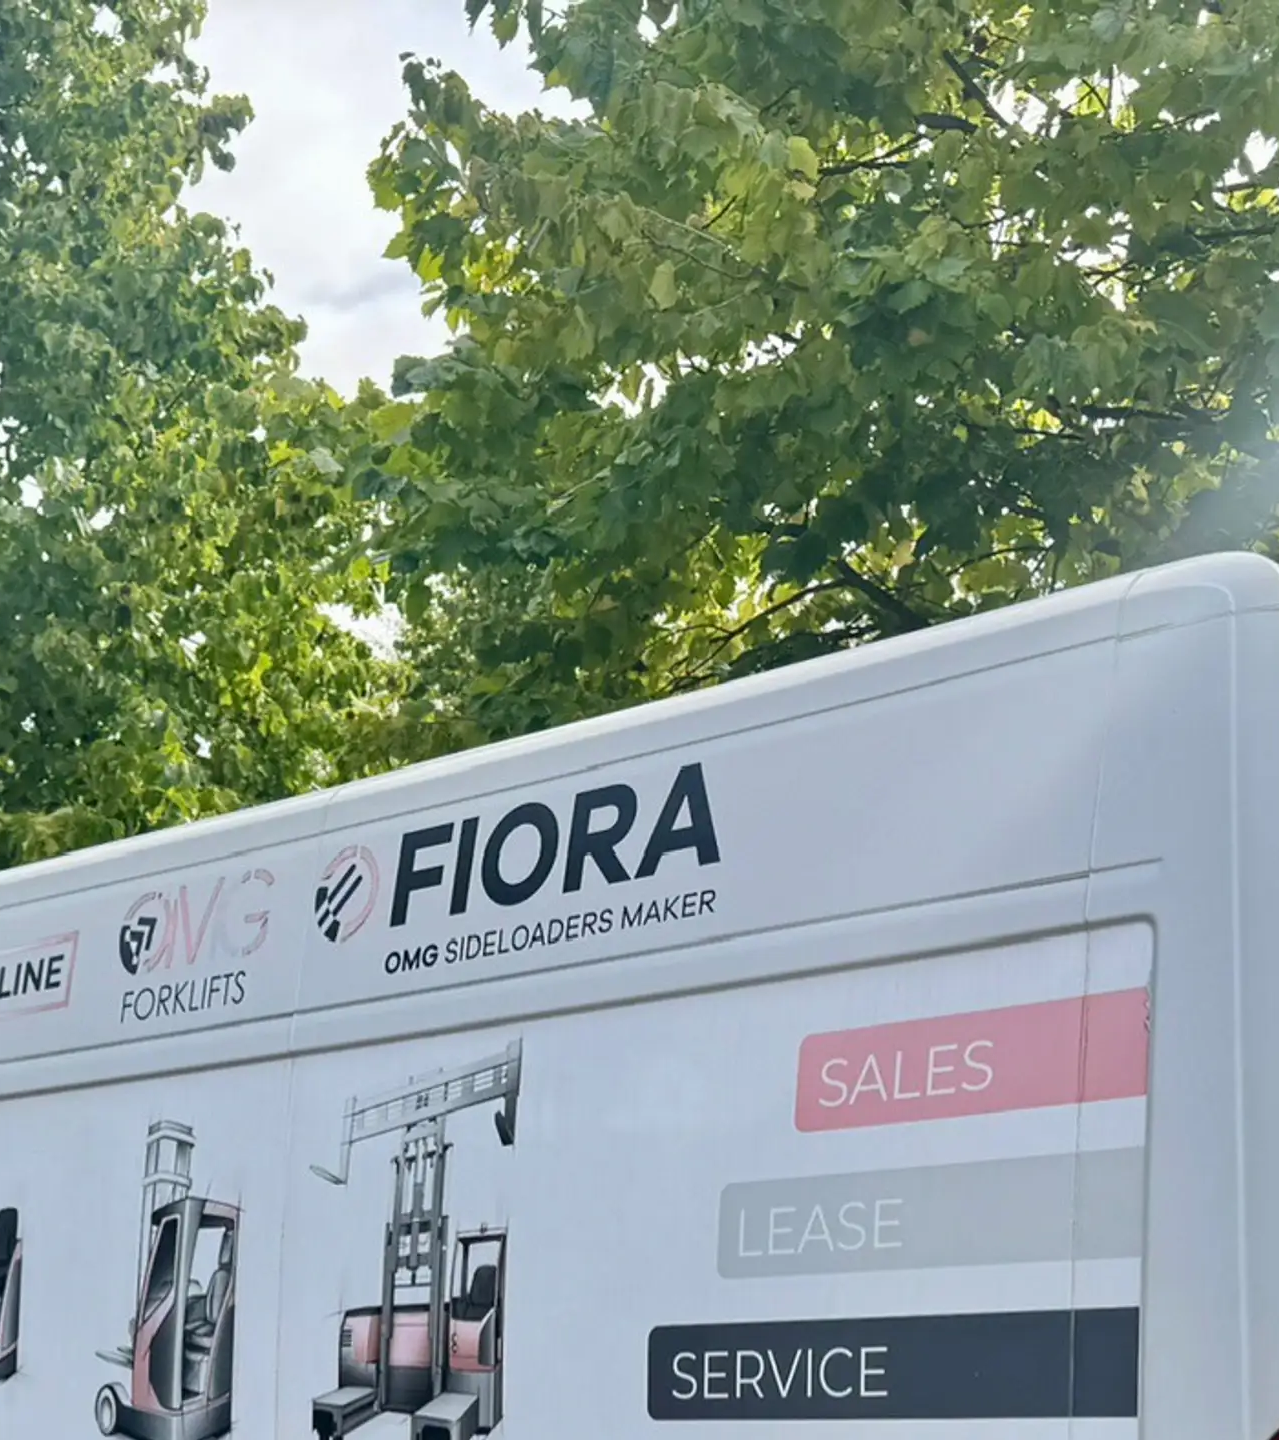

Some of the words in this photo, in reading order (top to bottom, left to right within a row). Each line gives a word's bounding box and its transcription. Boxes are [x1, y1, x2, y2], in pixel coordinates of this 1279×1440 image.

[389, 762, 721, 928] FIORA
[384, 944, 439, 975] OMG
[444, 907, 614, 964] SIDELOADERS
[621, 889, 717, 930] MAKER
[121, 971, 246, 1024] FORKLIFTS
[818, 1040, 996, 1107] SALES
[737, 1199, 904, 1258] LEASE
[671, 1346, 889, 1400] SERVICE
